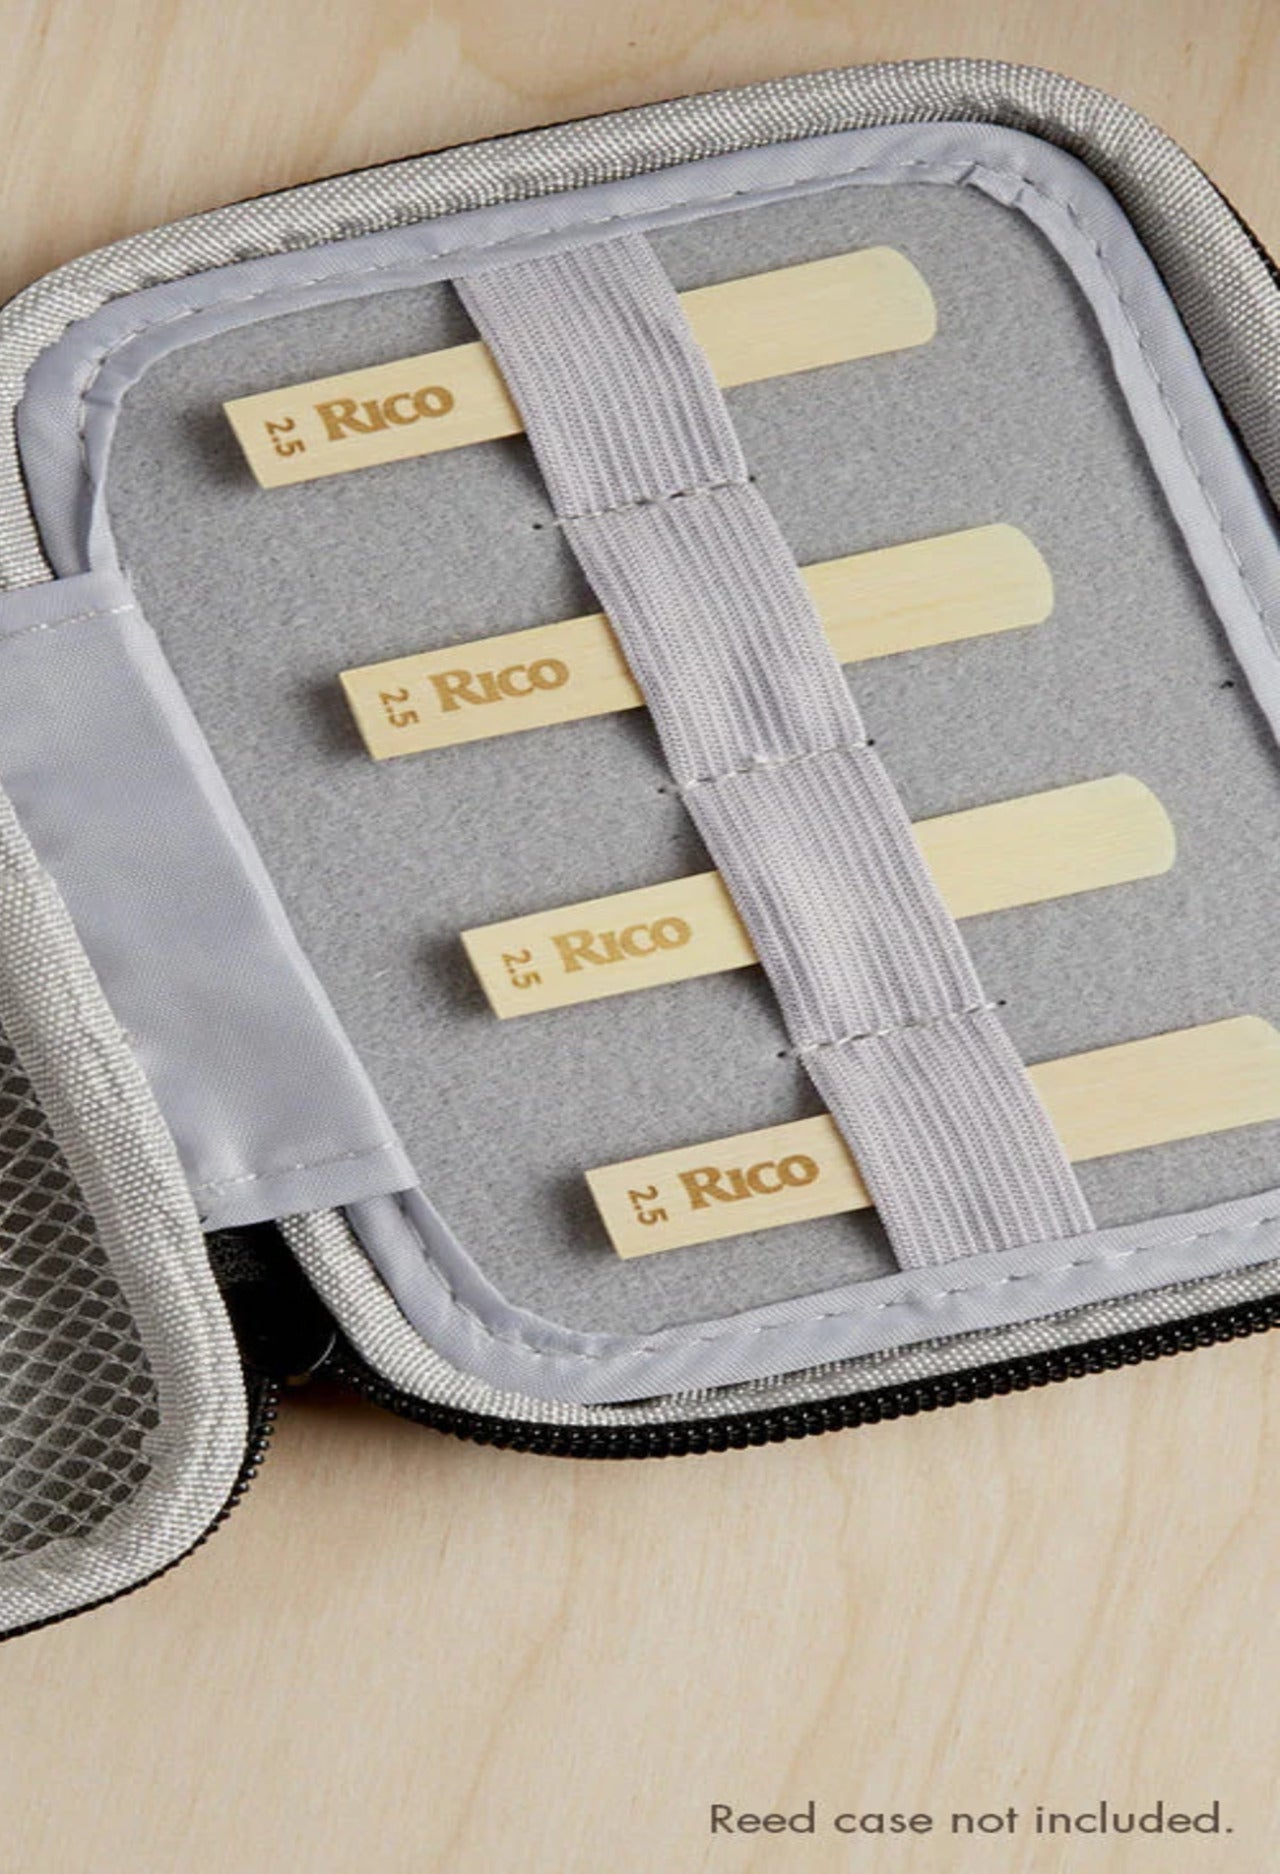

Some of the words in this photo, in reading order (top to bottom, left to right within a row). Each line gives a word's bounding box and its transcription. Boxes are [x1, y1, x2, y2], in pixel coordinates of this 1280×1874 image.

[264, 417, 306, 459] 2.5
[378, 687, 420, 728] 2.5
[501, 949, 542, 990] 2.5
[627, 1185, 668, 1226] 2.5
